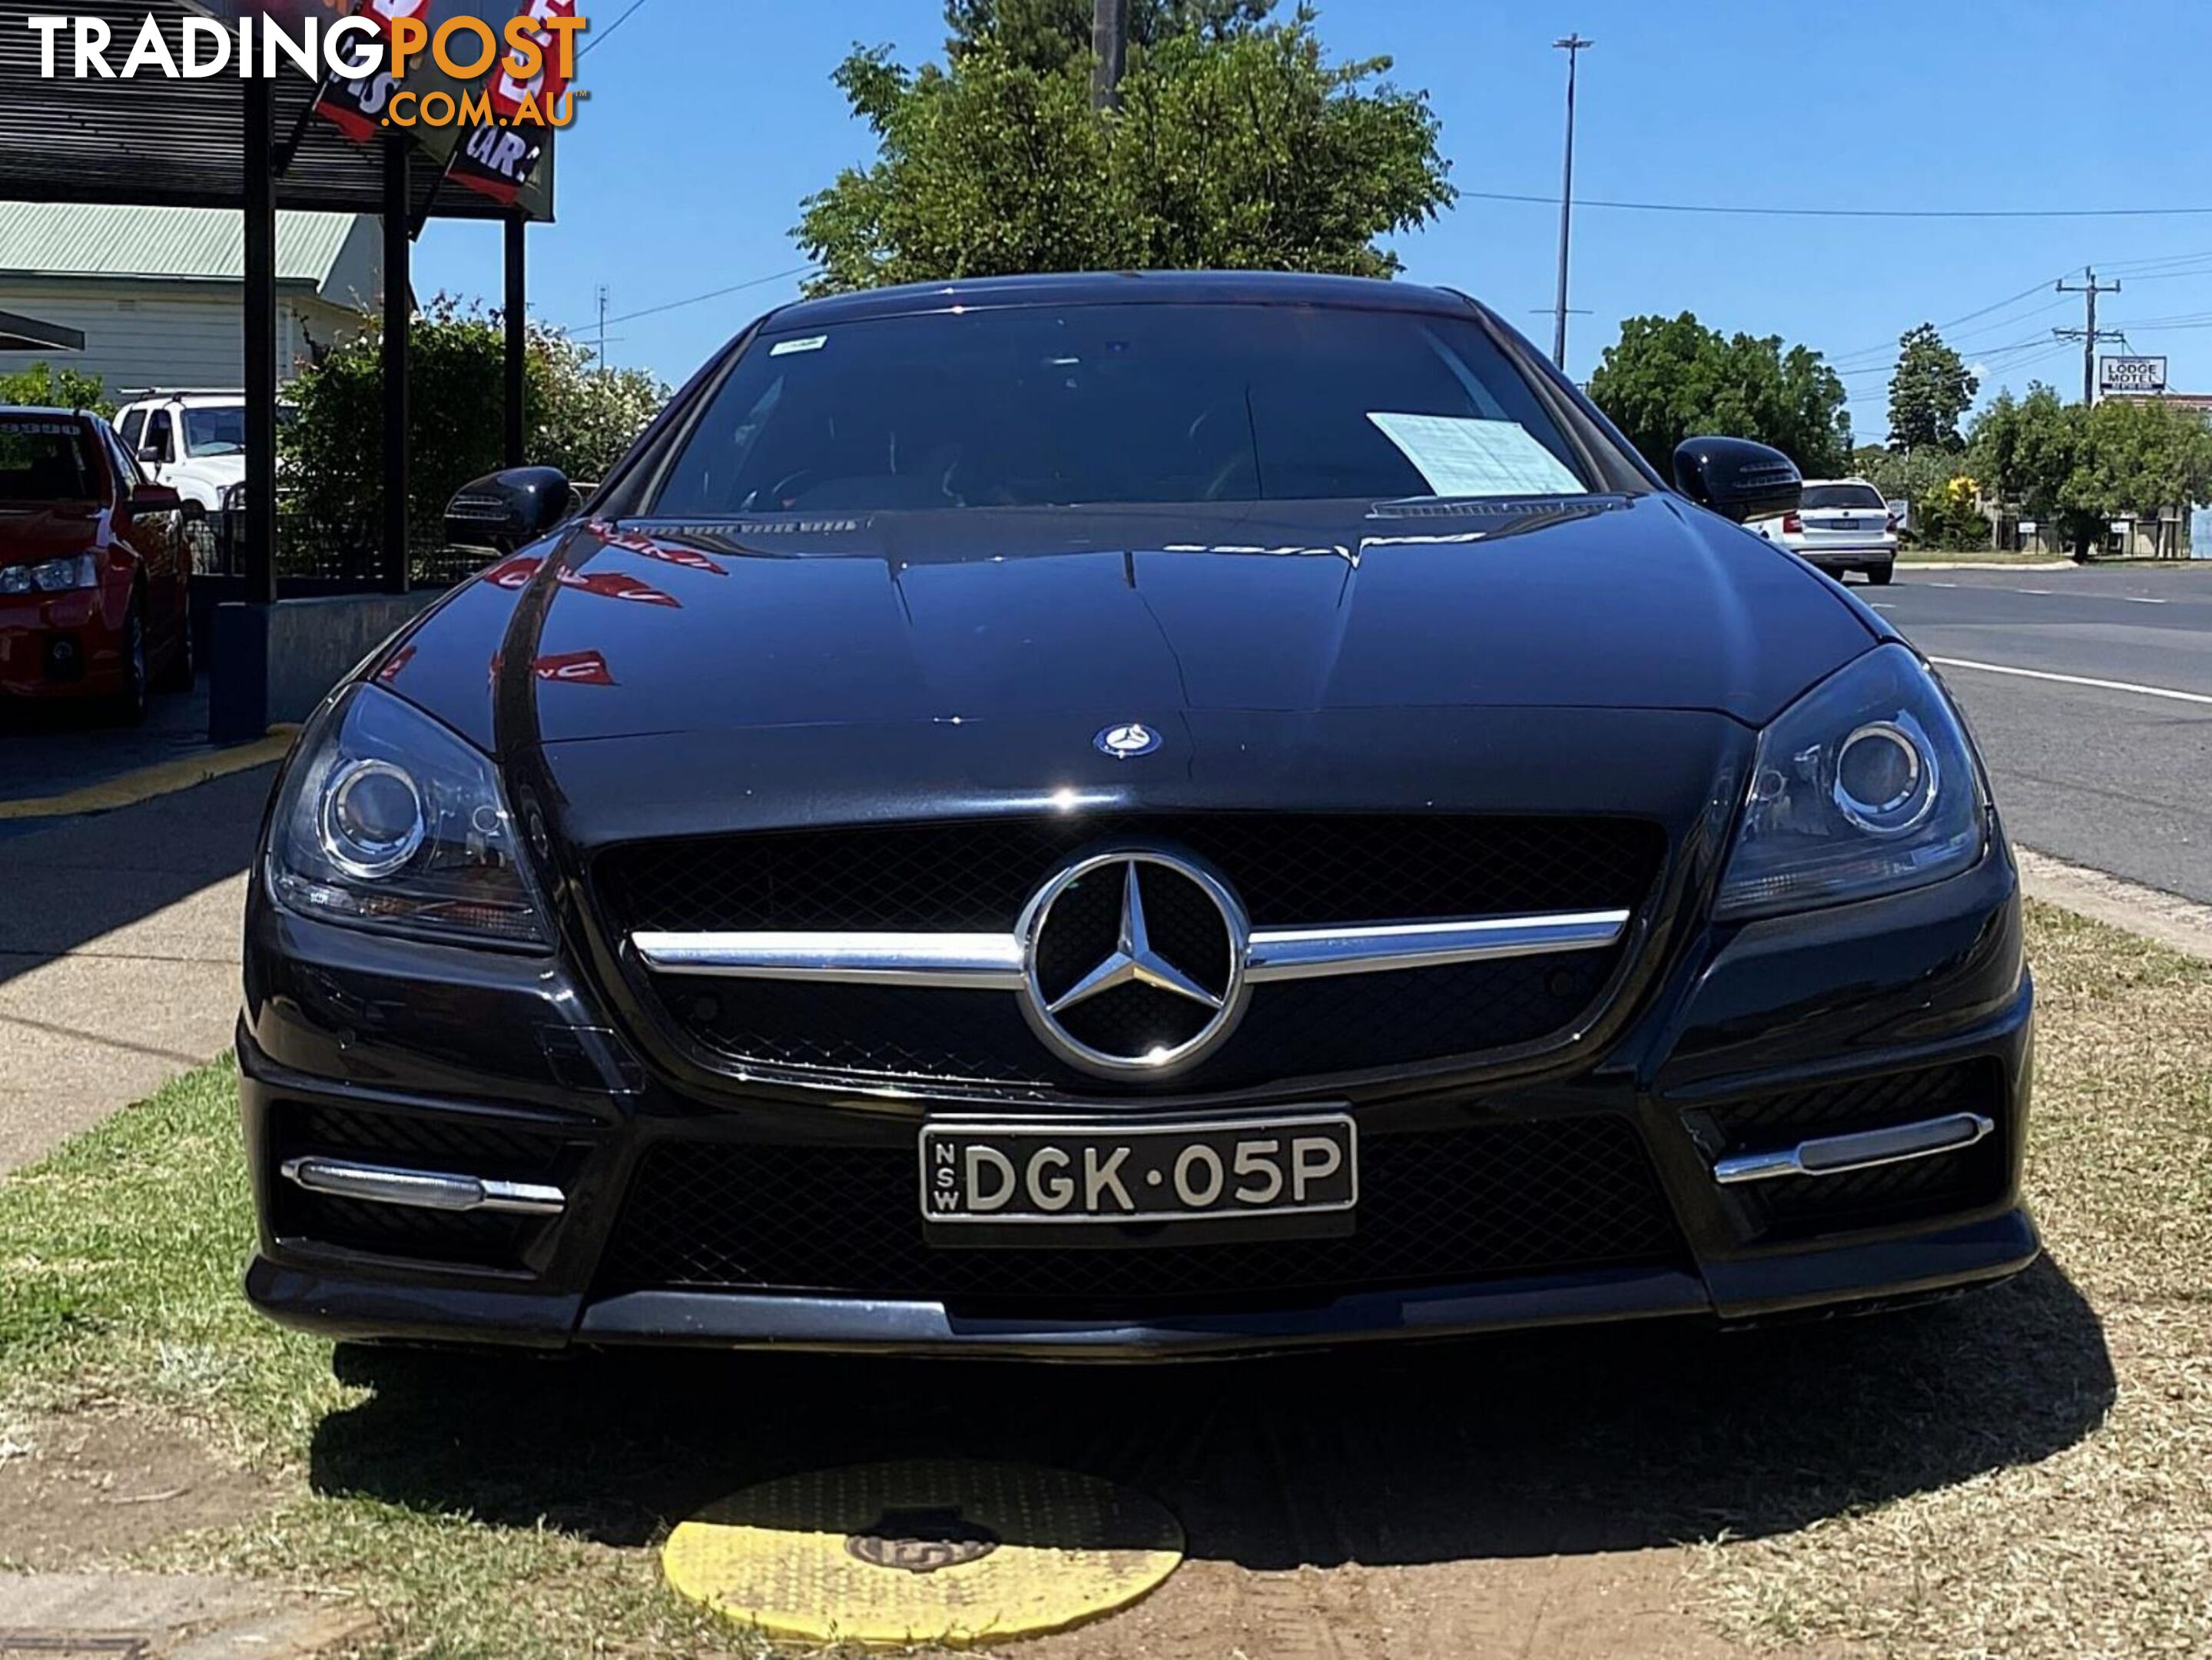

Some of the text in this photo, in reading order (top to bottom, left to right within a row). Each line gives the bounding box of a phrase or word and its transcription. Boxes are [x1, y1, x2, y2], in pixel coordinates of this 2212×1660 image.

[2108, 364, 2157, 374] LODGE
[2108, 374, 2156, 383] MOTEL
[934, 1143, 959, 1210] NSW
